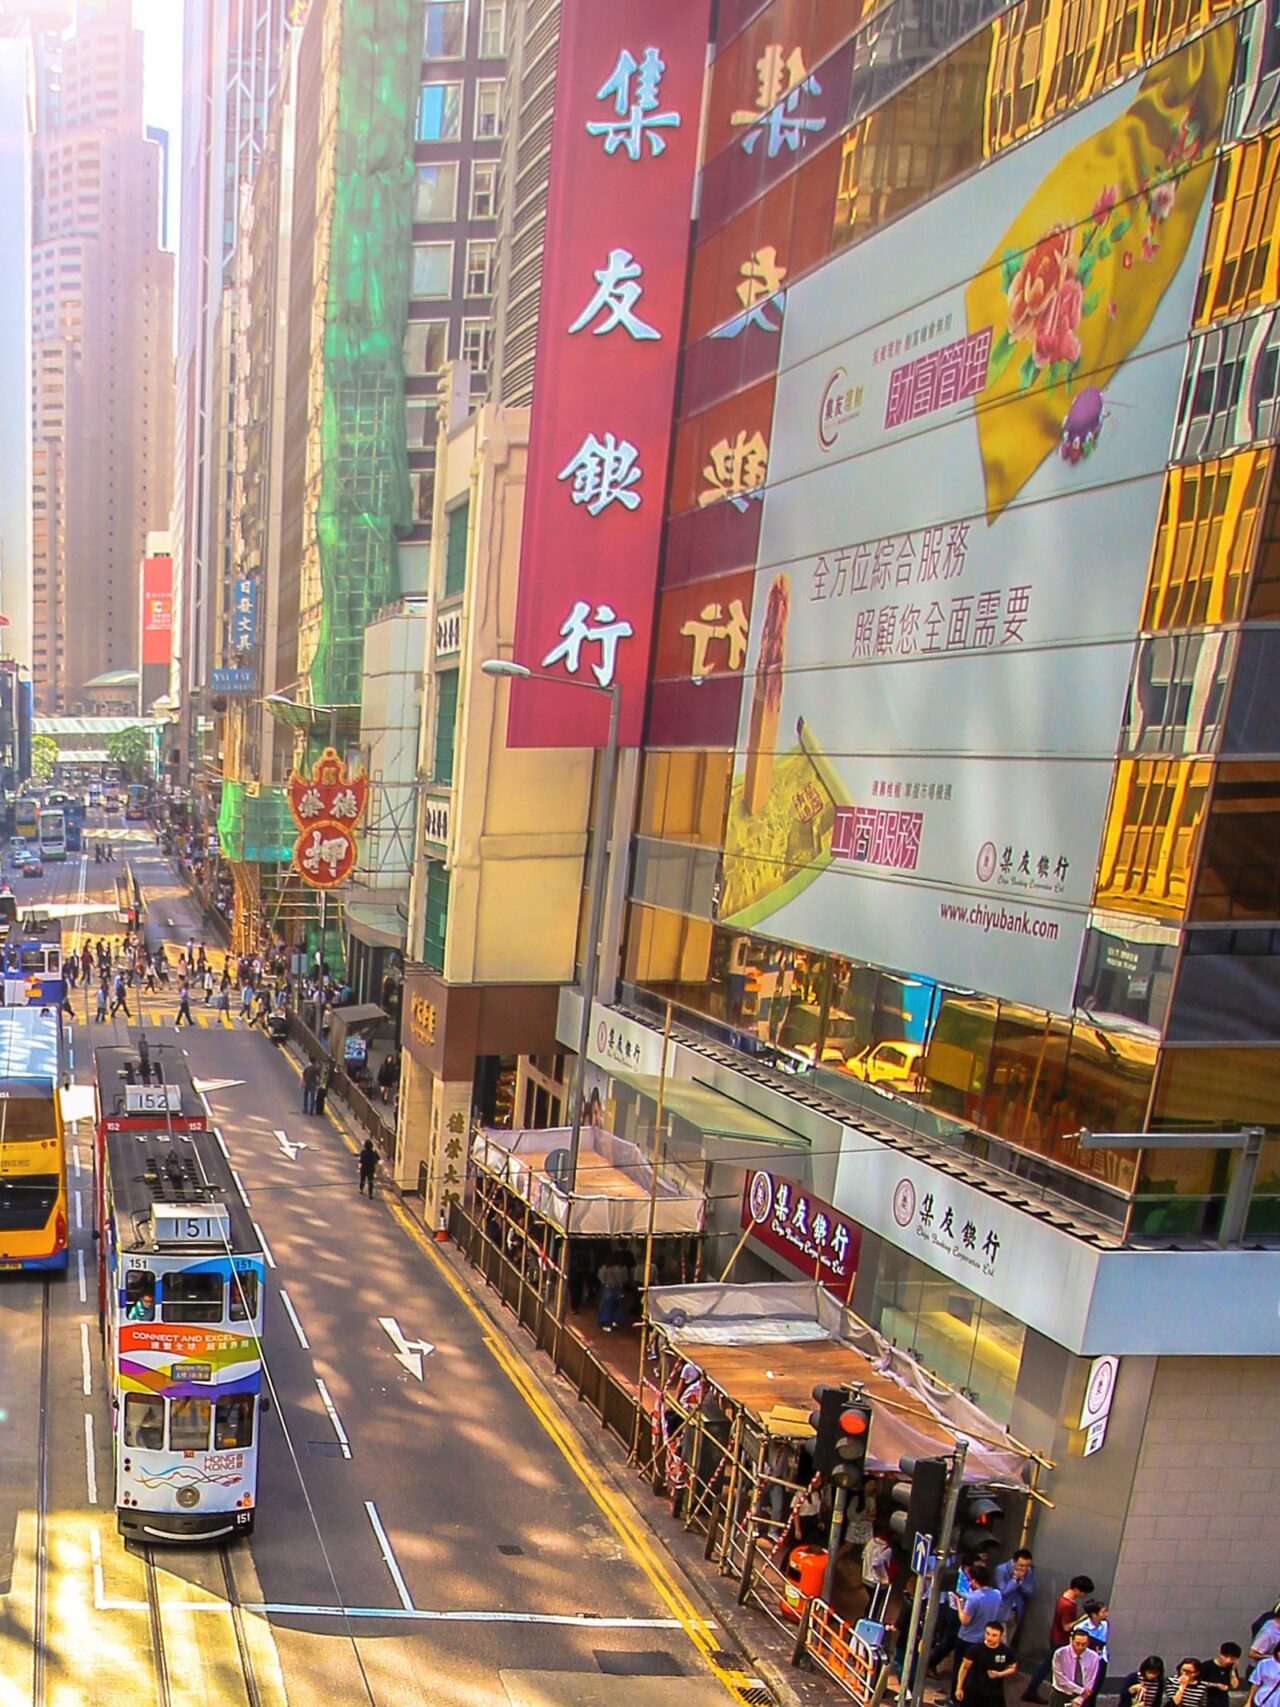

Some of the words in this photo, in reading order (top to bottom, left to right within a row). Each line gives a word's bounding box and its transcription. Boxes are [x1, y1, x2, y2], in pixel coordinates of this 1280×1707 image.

[542, 46, 681, 688] 集友銀行
[885, 331, 991, 426] 財富管理
[810, 523, 970, 602] 全方位綜合服務
[851, 585, 1033, 659] 照顧您全面需要
[303, 831, 349, 878] 押
[830, 811, 924, 870] 工商服務
[999, 846, 1070, 882] 集友銀行
[940, 903, 1059, 940] www.chiyubank.com
[139, 1095, 168, 1108] 152
[107, 1122, 120, 1131] 152
[189, 1122, 202, 1131] 152
[175, 1218, 211, 1238] 151
[773, 1183, 849, 1261] 集友銀行
[919, 1192, 1000, 1264] 集友銀行
[130, 1259, 147, 1269] 151
[236, 1259, 251, 1269] 151
[132, 1331, 180, 1342] CONNECT
[181, 1334, 203, 1343] AND
[205, 1334, 236, 1343] EXCEL
[204, 1455, 236, 1464] HONG
[204, 1462, 235, 1472] KONG
[236, 1512, 251, 1525] 151
